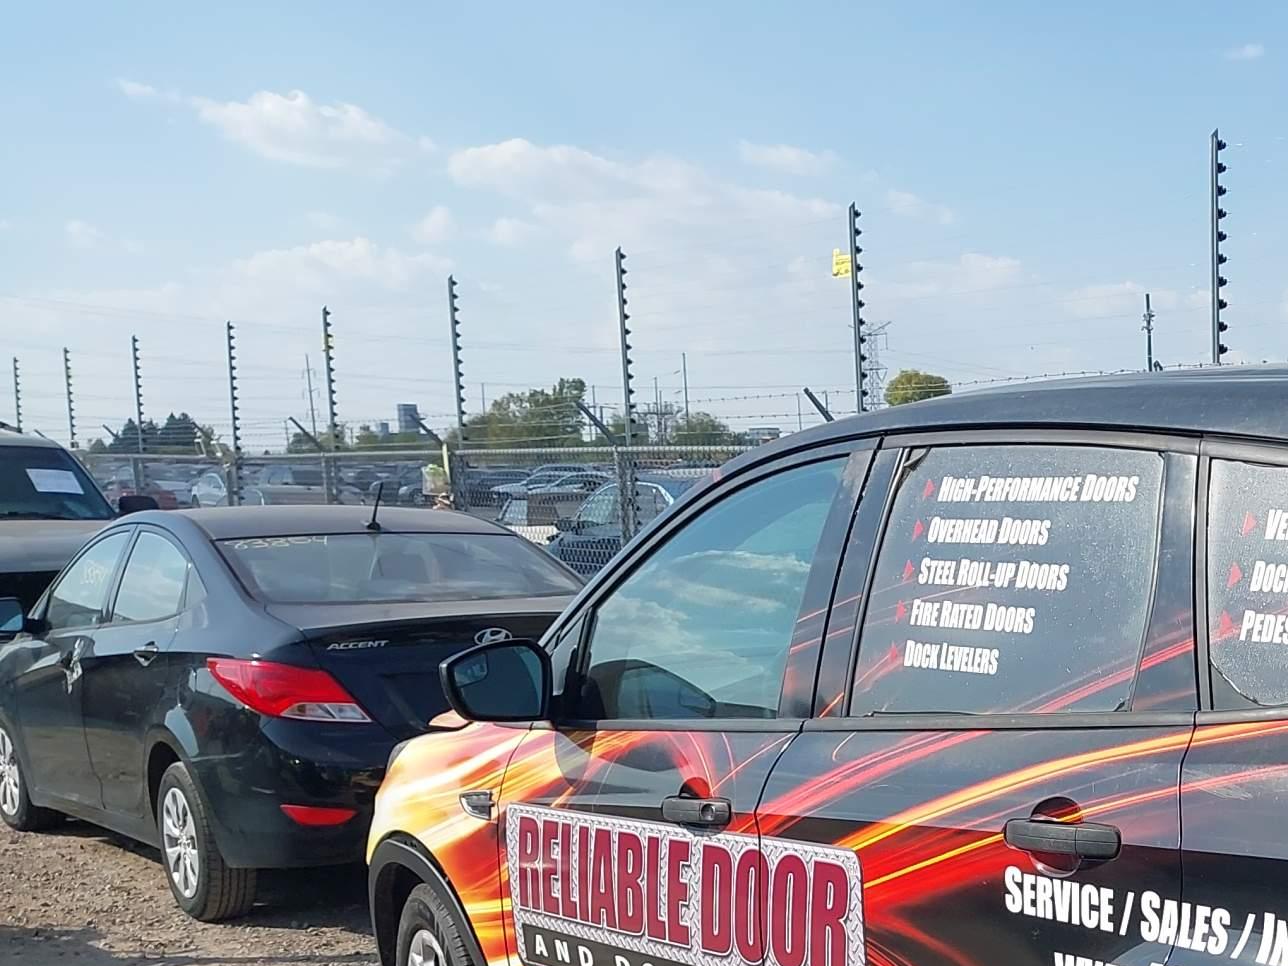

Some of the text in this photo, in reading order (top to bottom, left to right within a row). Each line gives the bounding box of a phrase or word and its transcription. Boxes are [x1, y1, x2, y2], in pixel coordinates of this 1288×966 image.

[937, 474, 1139, 502] HIGH-PERFORMANCE DOORS
[927, 516, 1051, 546] OVERHEAD DOORS
[918, 557, 958, 585] STEEL
[1015, 560, 1070, 591] DOORS
[910, 599, 1036, 634] FIRE RATED DOORS
[326, 639, 390, 651] ACCENT
[903, 639, 1000, 675] DOCK LEVELERS
[517, 814, 693, 949] RELIABLE
[1004, 865, 1115, 933] SERVICE
[1119, 891, 1135, 936] /
[1140, 890, 1231, 956] SALES
[1232, 913, 1256, 959] /
